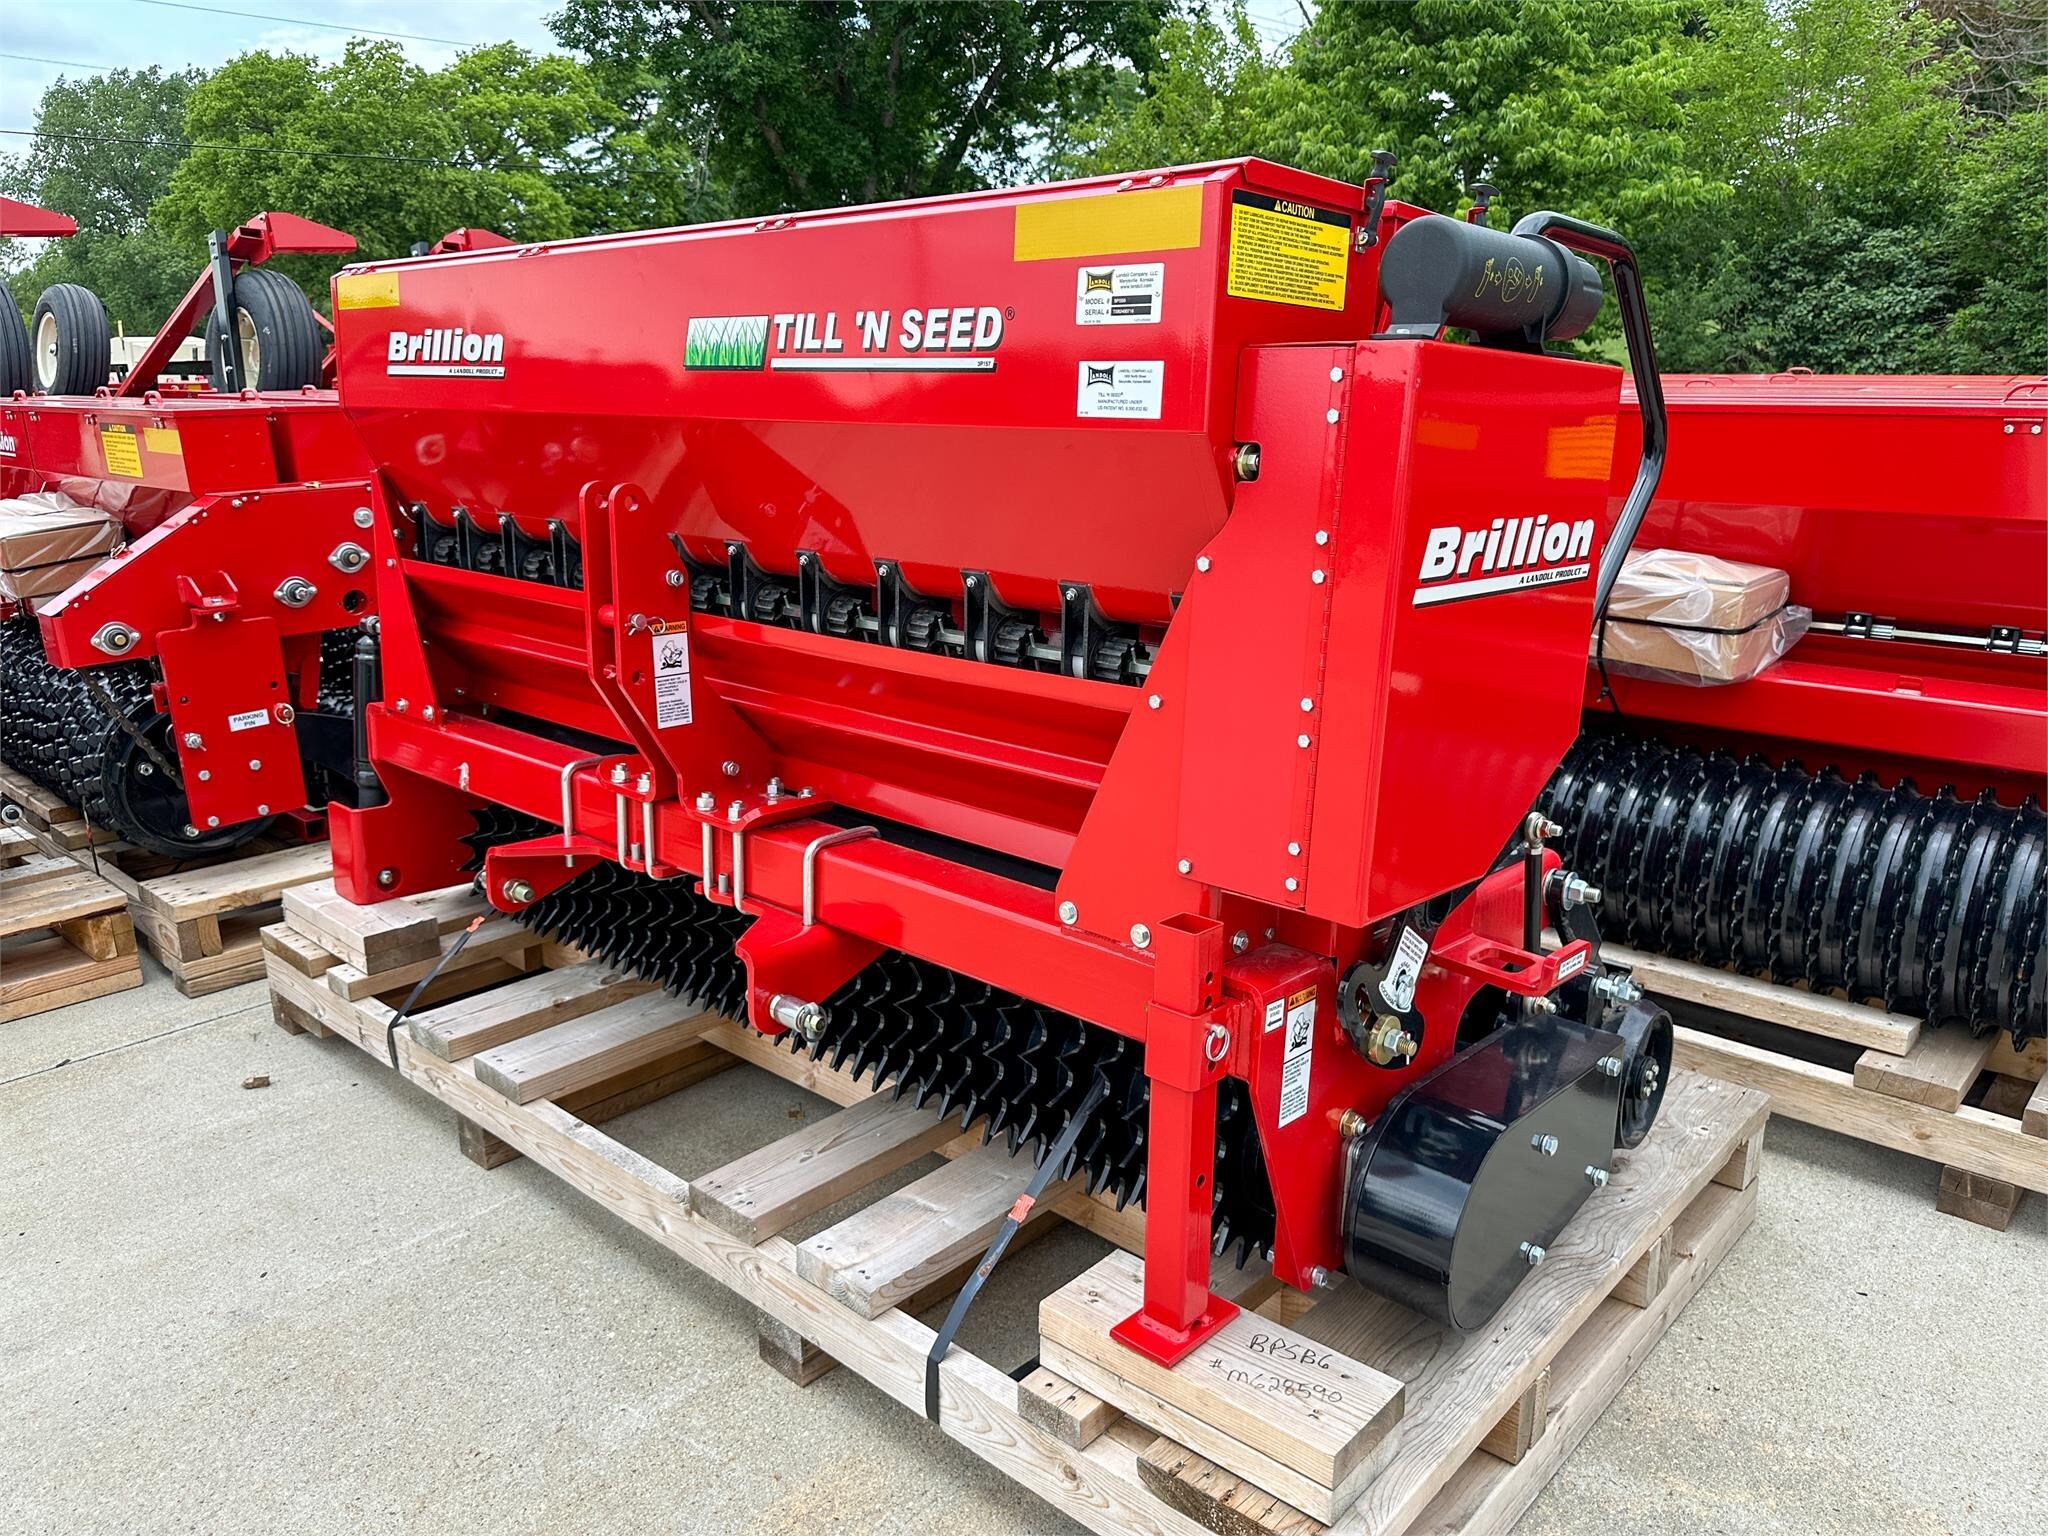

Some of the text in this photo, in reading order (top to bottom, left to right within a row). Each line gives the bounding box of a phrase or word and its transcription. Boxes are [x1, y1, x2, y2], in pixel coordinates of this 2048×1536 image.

[1281, 200, 1315, 220] CAUTION
[1088, 275, 1111, 290] LANDOLL
[773, 312, 844, 352] TILL
[856, 310, 890, 351] 'N
[388, 328, 504, 362] Brillion
[1089, 369, 1112, 384] LANDOLL
[1419, 514, 1595, 582] Brillion
[1526, 571, 1554, 585] LANDOLL
[1555, 567, 1582, 580] PRODUCT
[233, 712, 264, 723] PARKING
